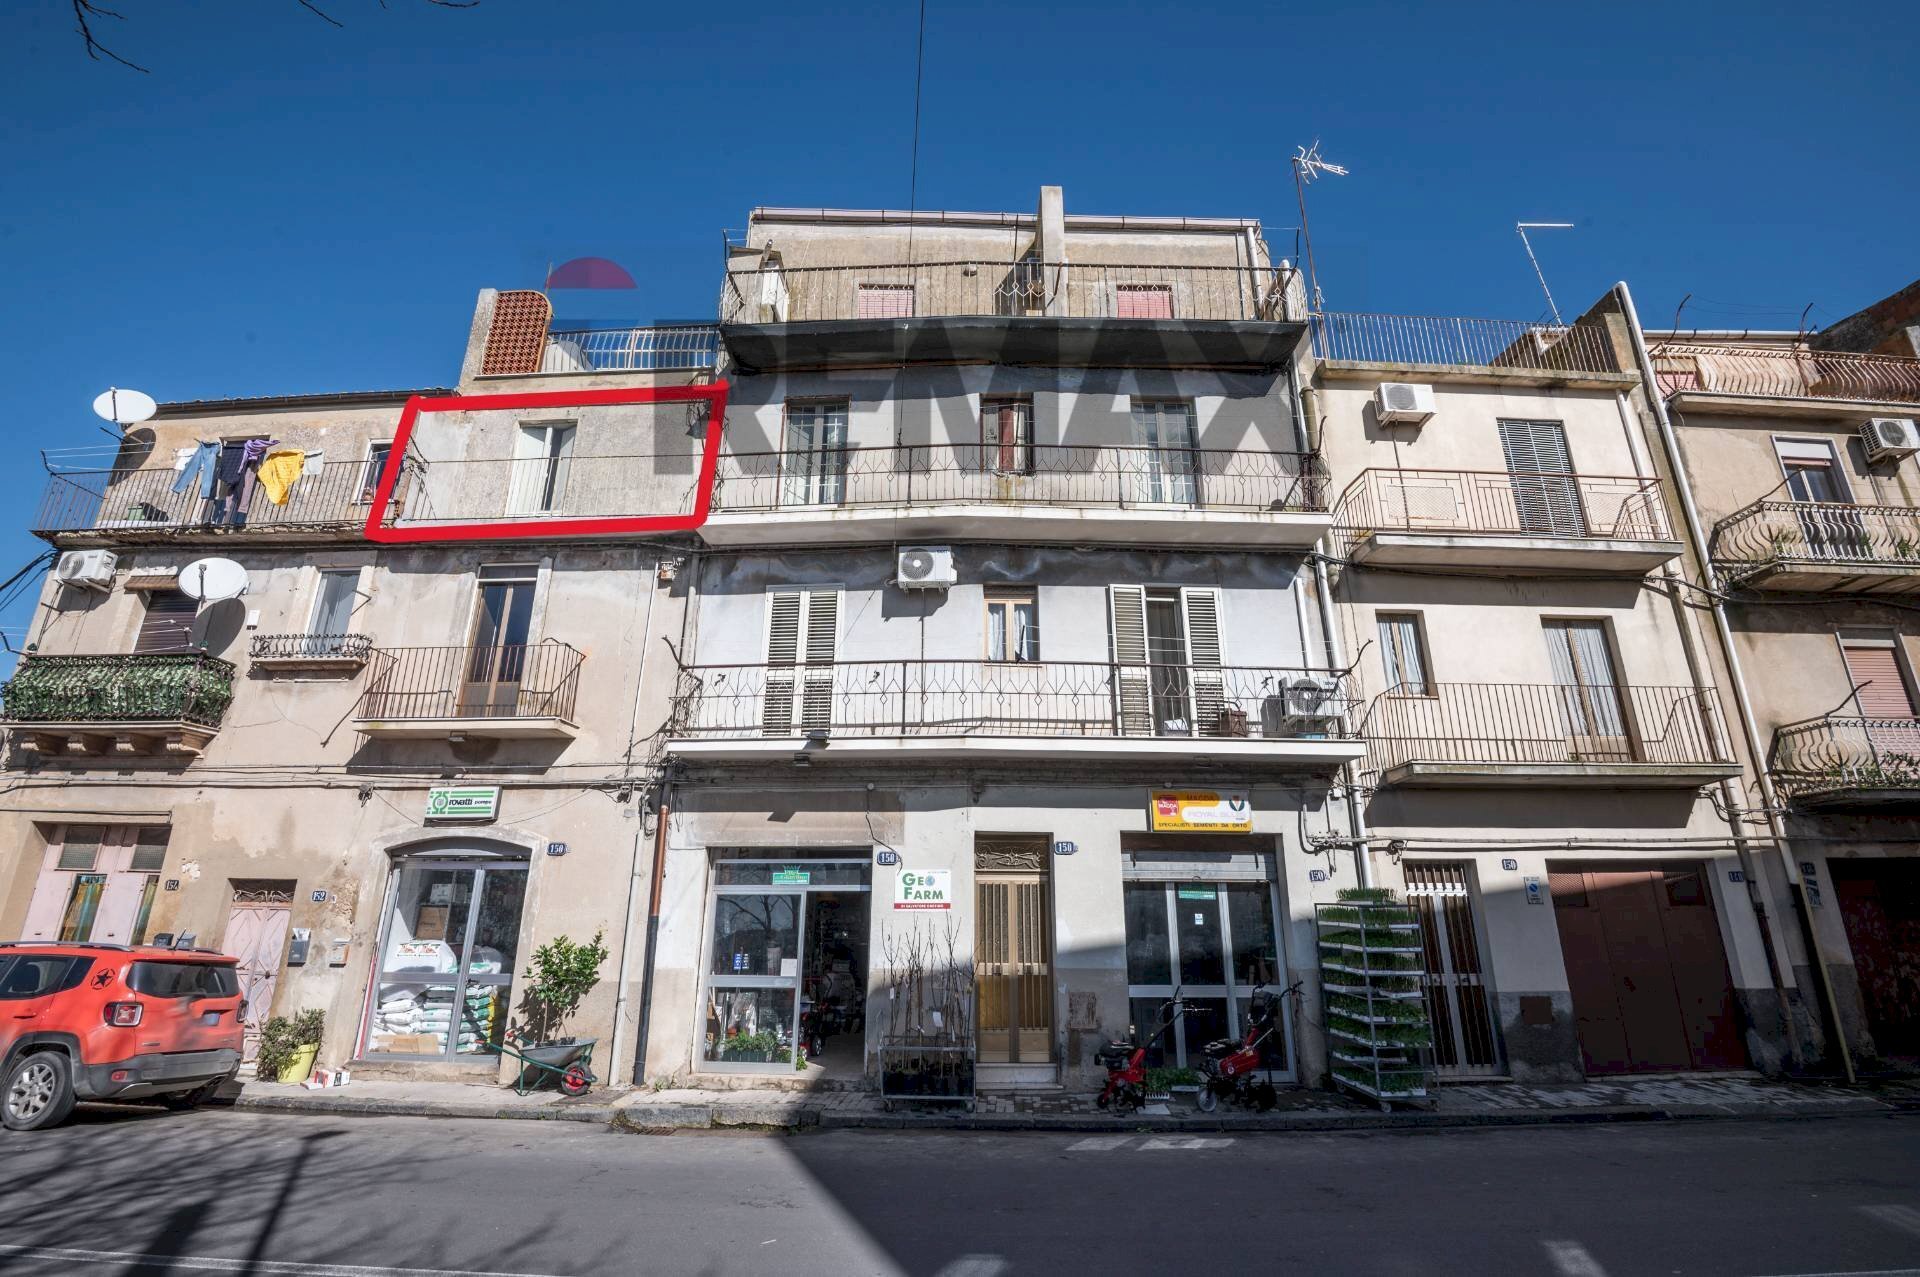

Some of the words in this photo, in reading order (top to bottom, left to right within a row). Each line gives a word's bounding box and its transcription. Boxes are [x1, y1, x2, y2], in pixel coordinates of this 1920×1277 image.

[448, 798, 473, 806] rovatti
[1058, 842, 1072, 852] 150
[881, 853, 895, 863] 150
[1311, 870, 1324, 881] 150
[313, 891, 326, 901] 152
